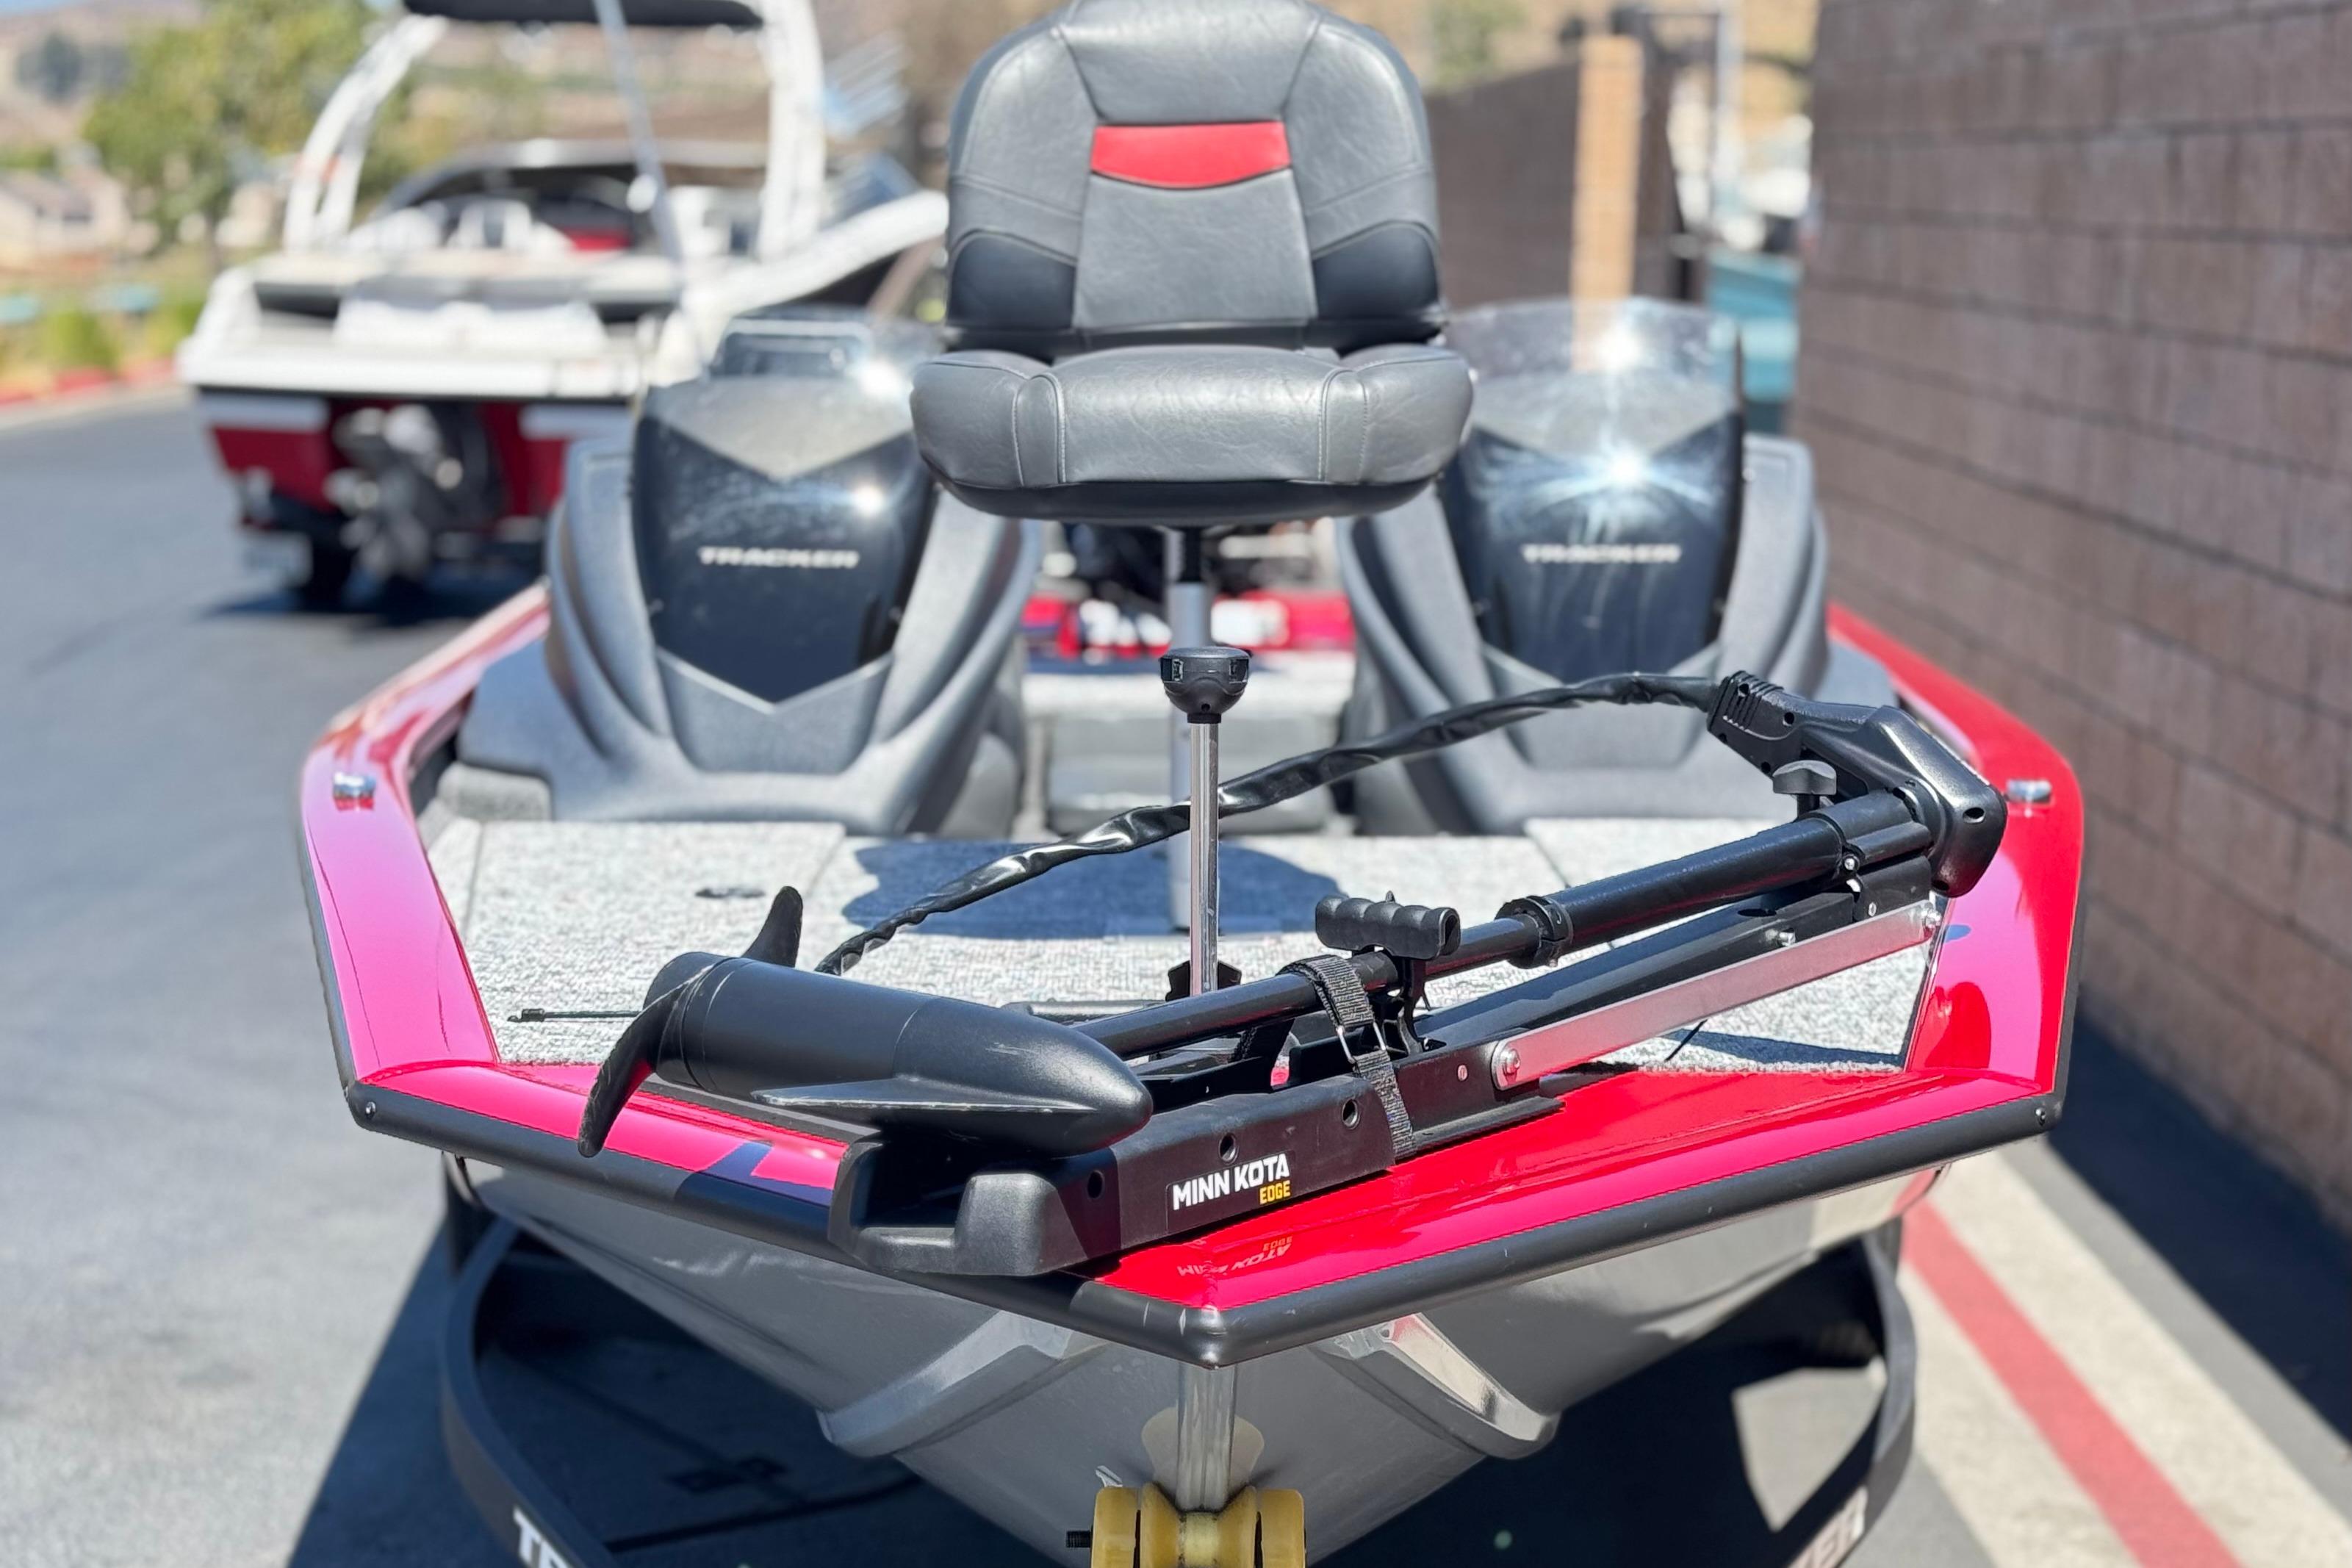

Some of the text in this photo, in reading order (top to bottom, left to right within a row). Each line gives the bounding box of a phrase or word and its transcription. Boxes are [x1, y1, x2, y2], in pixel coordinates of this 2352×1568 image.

[700, 546, 860, 569] TRACKER
[1173, 1153, 1290, 1210] MINN KOTA
[1259, 1180, 1291, 1205] EDGE
